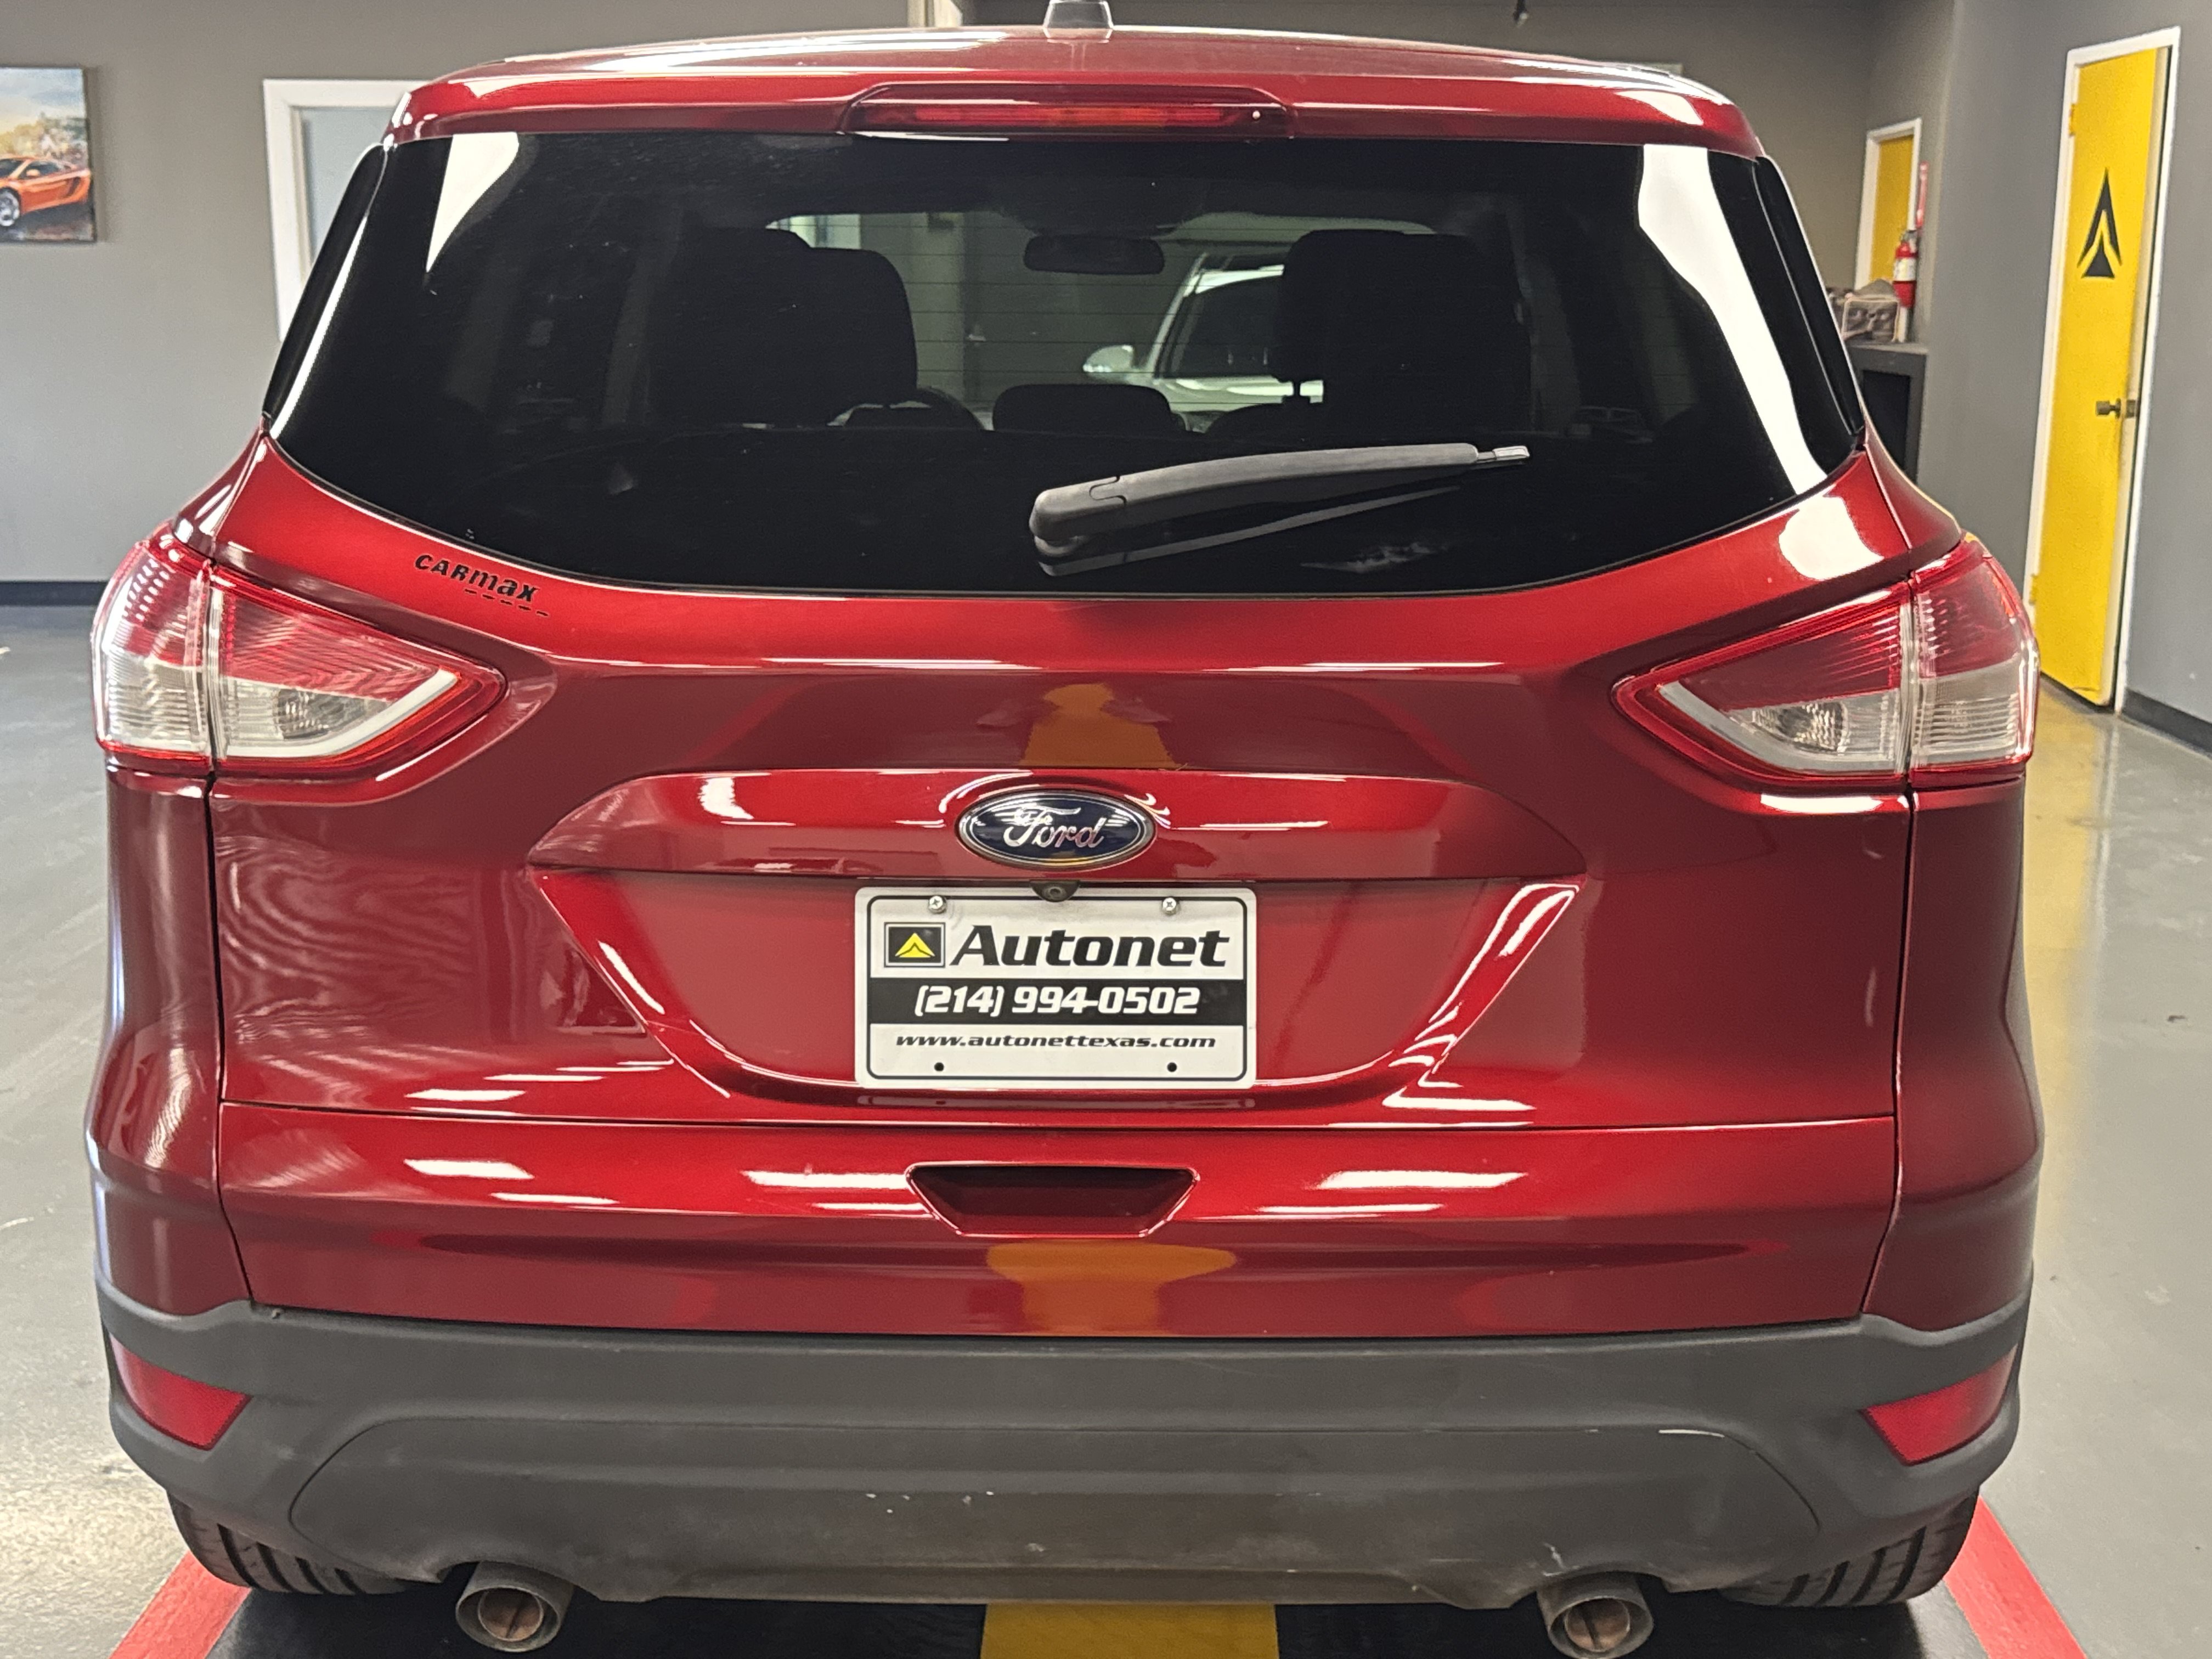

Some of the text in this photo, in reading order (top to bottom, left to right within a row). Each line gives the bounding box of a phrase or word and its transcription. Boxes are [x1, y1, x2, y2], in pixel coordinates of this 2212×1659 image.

[1003, 805, 1105, 849] Ford
[950, 924, 1229, 967] Autonet
[915, 985, 1200, 1017] (214) 994-0502
[896, 1035, 1216, 1049] www.autonettexas.com
